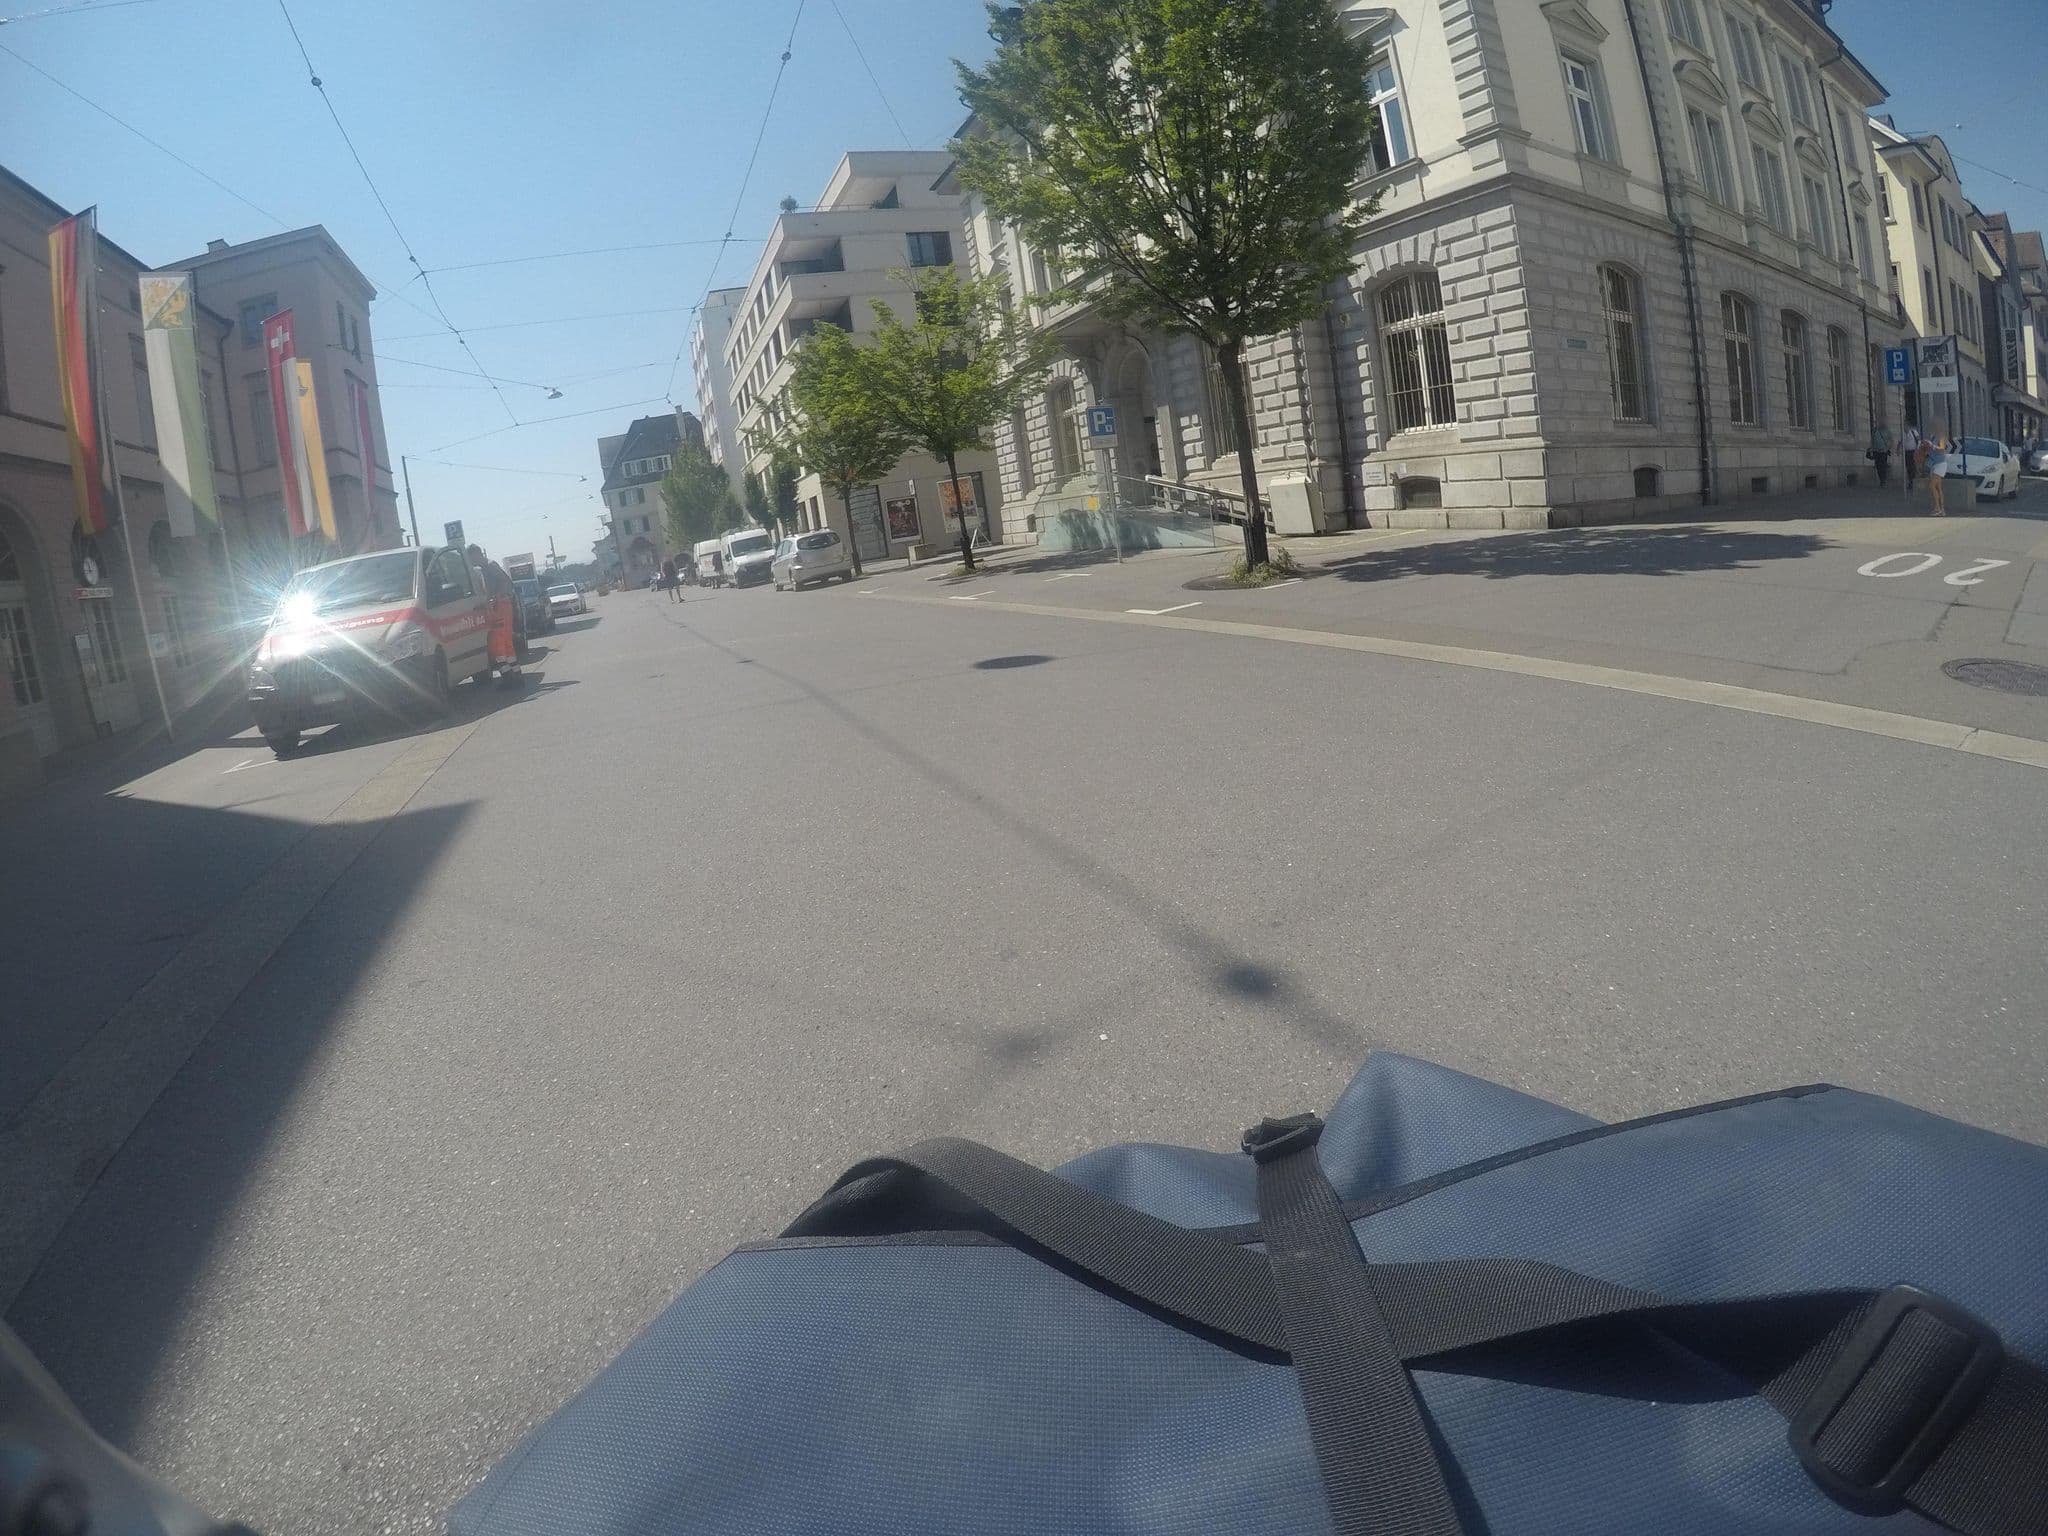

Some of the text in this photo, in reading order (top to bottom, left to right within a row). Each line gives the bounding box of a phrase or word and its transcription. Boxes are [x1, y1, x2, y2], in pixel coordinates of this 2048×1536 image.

[1893, 351, 1903, 367] P
[1093, 411, 1107, 432] P
[1857, 552, 2012, 586] 20
